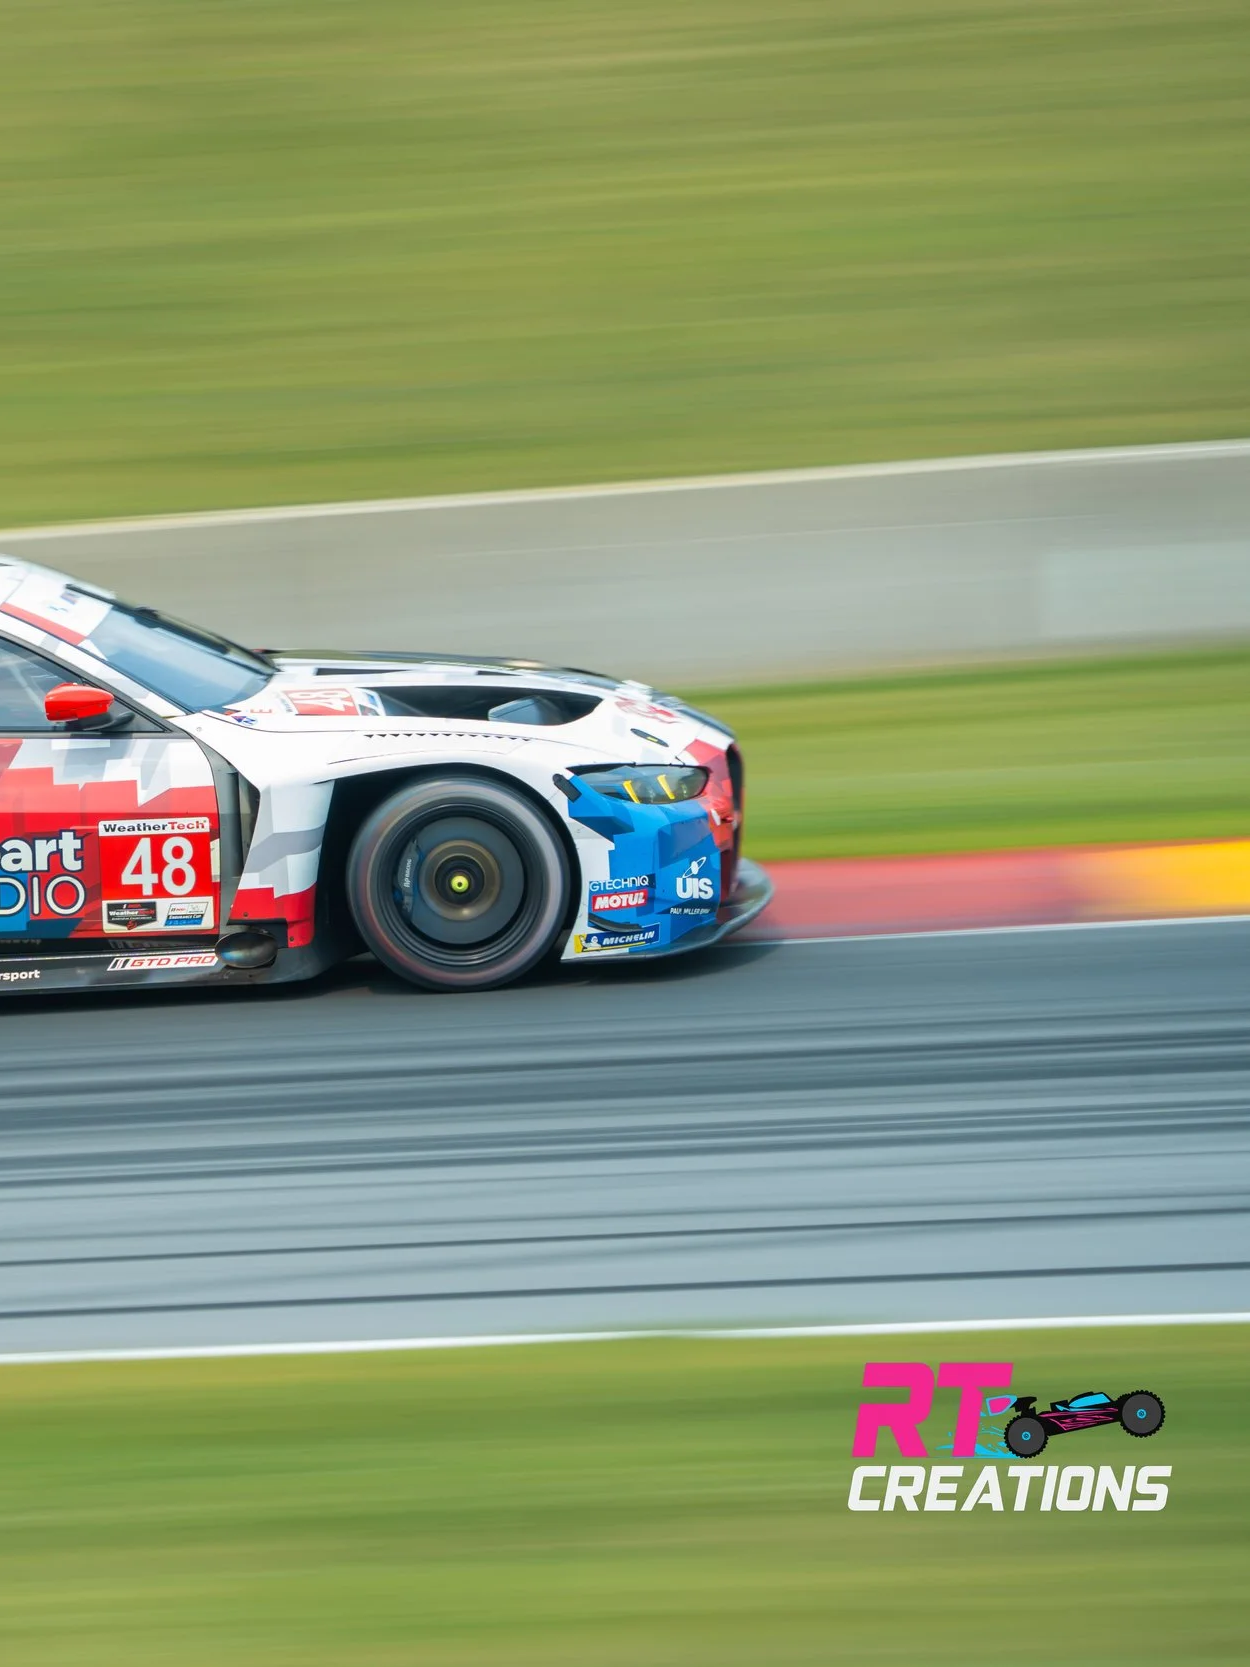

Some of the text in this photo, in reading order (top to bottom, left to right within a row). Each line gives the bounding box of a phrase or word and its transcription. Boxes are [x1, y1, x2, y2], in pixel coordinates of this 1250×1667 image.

[103, 820, 205, 832] WeatherTech
[121, 836, 196, 896] 48
[589, 875, 649, 892] GTECHNIQ
[676, 877, 714, 899] UIS
[594, 892, 646, 910] MOTUL
[602, 931, 655, 945] MICHELIN
[130, 955, 216, 967] GTD PRO
